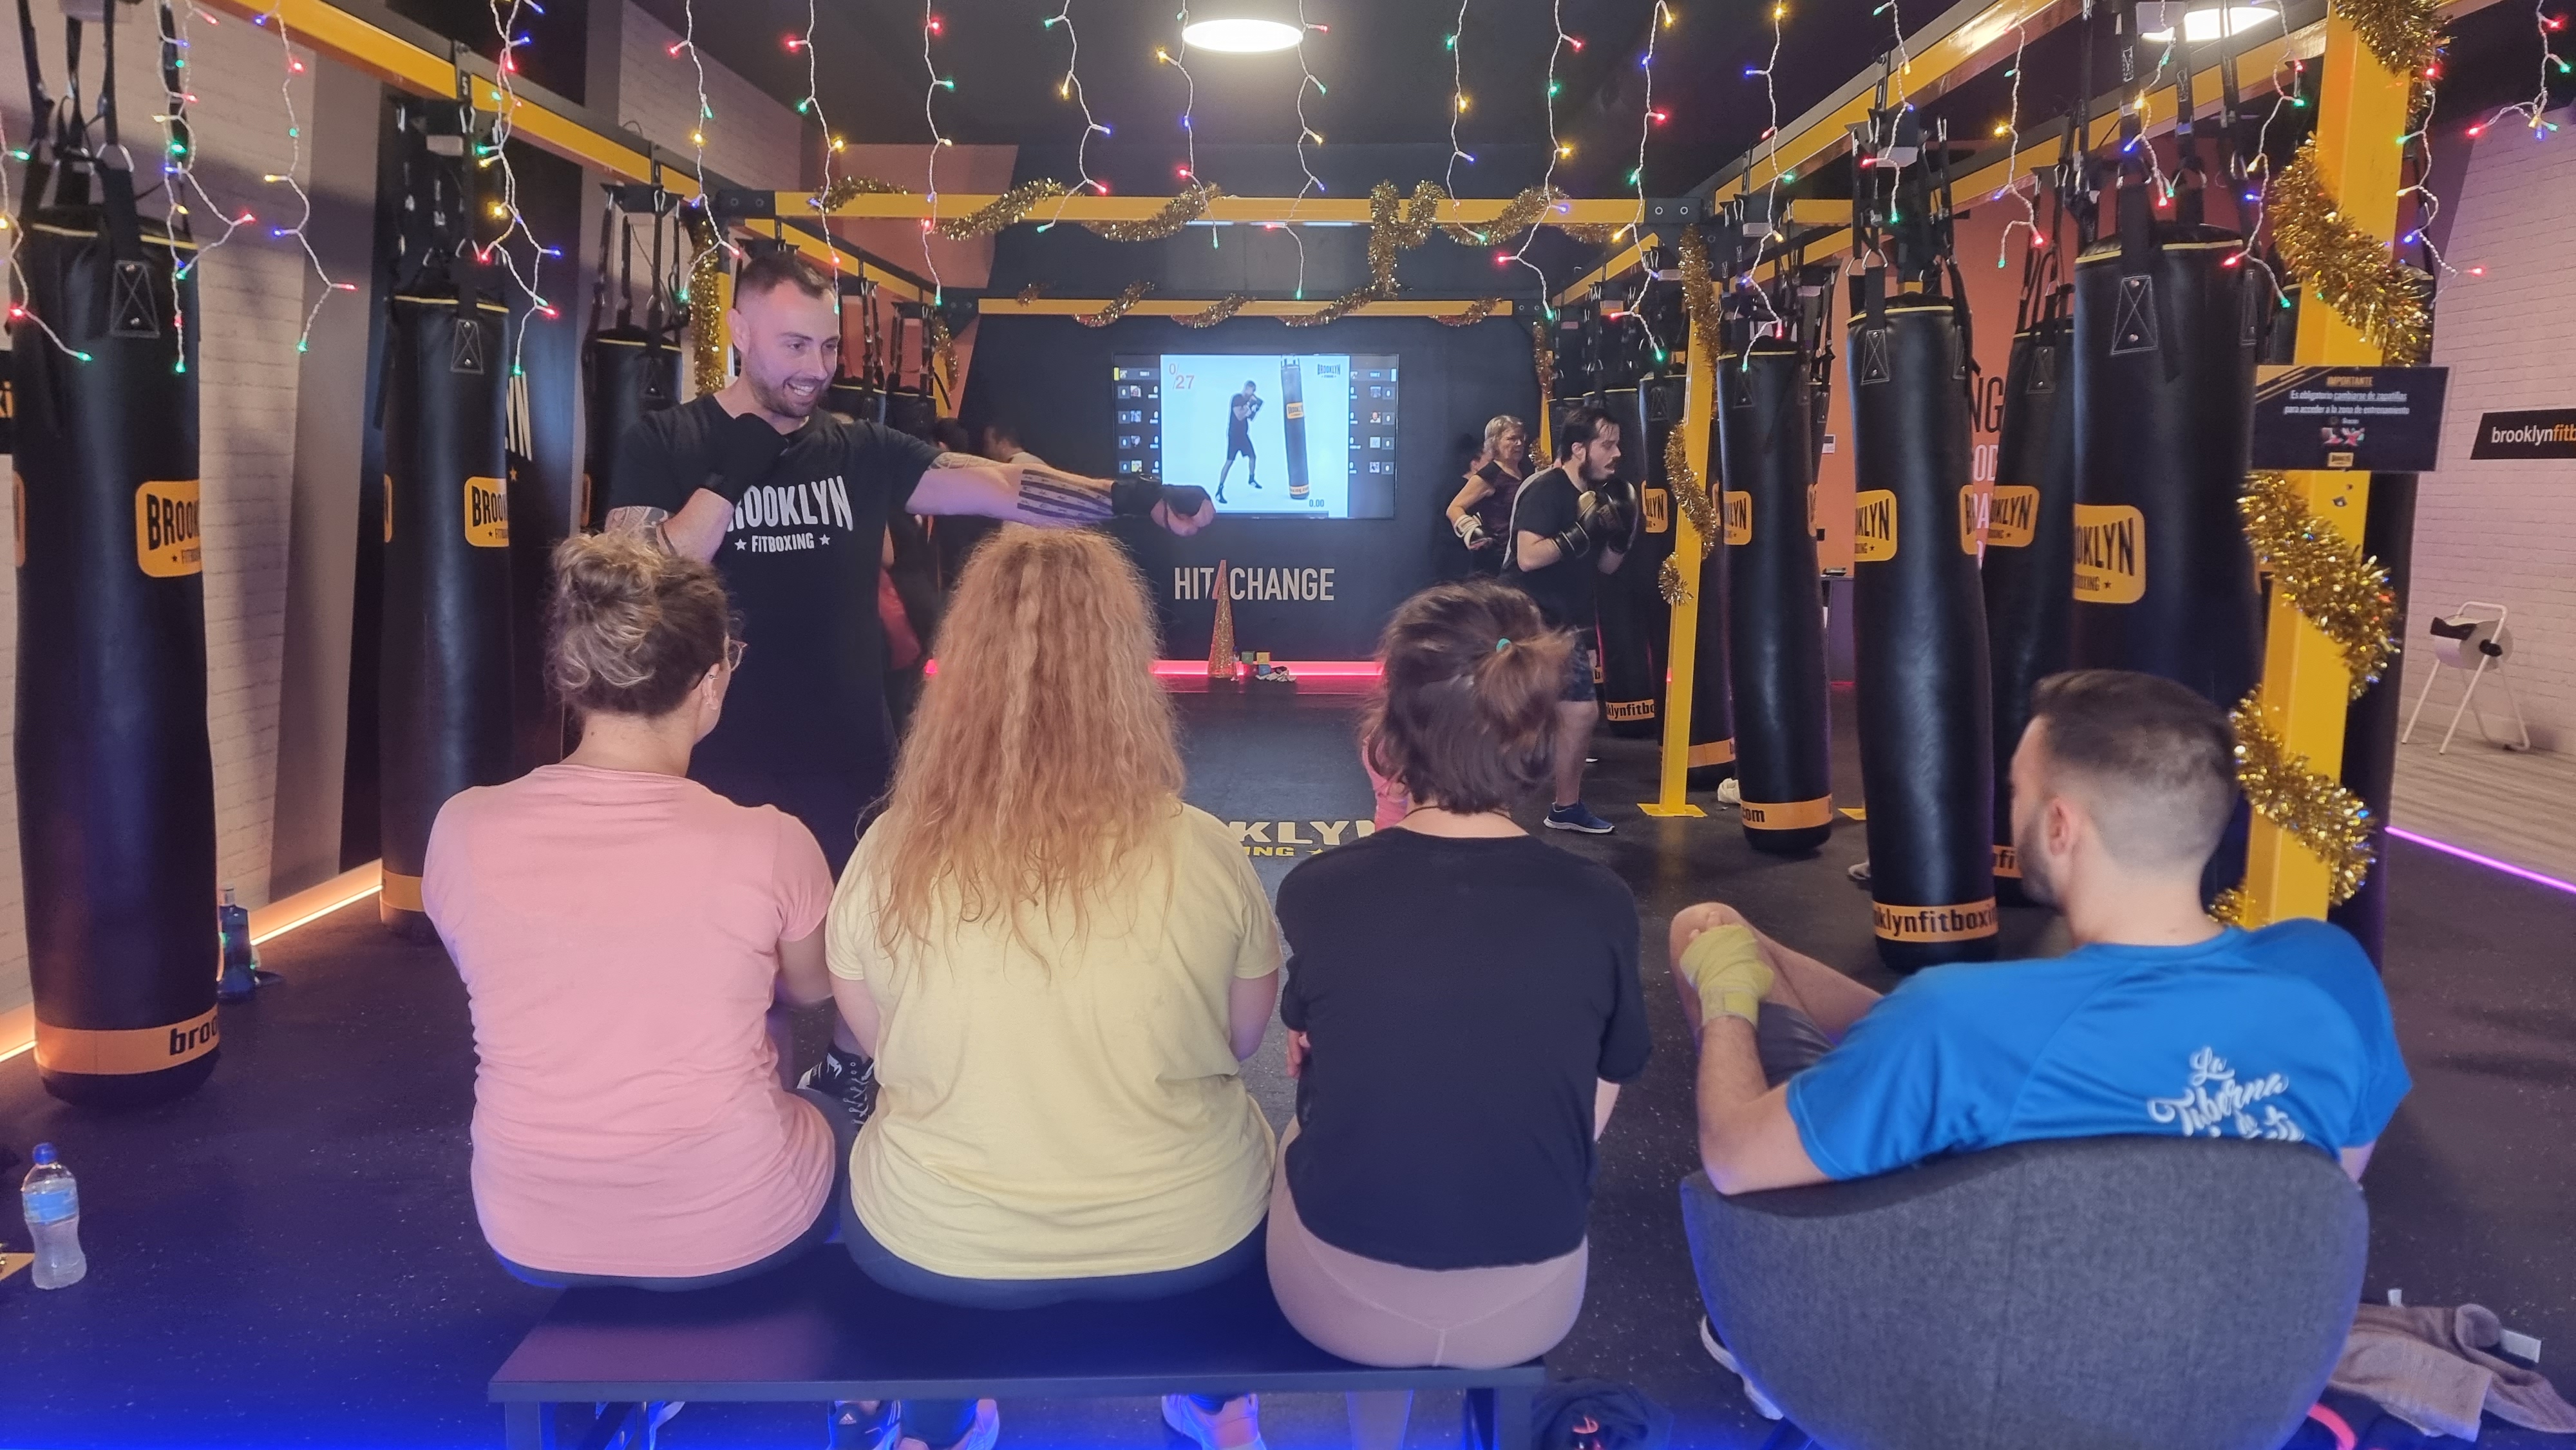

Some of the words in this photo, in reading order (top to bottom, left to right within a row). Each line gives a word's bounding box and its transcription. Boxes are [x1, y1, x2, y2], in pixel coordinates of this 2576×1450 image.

[2327, 377, 2374, 386] IMPORTANTE
[2290, 390, 2299, 399] Es
[727, 475, 853, 532] ROOKLYN
[1309, 499, 1324, 507] 0.00
[752, 532, 815, 552] FITBOXING
